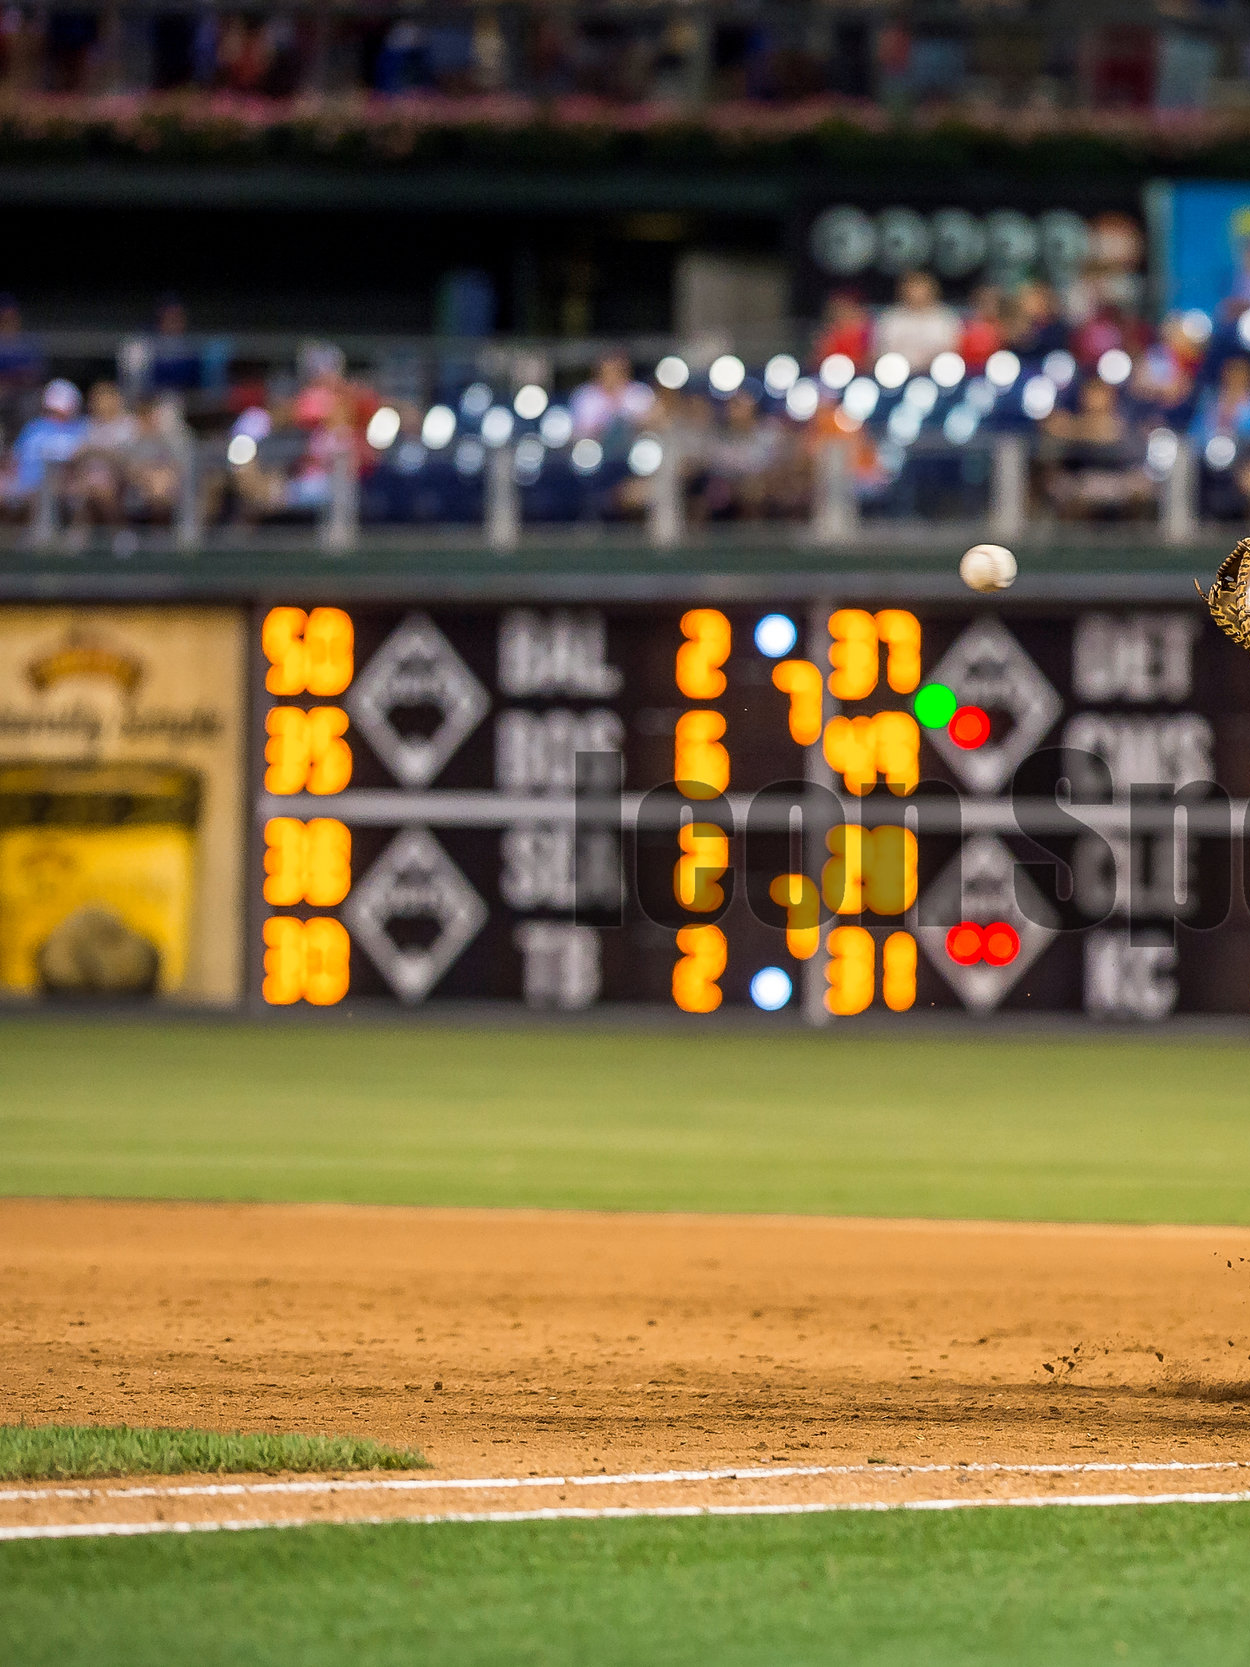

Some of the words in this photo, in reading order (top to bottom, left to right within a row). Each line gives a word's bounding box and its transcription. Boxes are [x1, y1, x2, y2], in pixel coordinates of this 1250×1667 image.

[675, 608, 732, 699] 2
[827, 608, 922, 700] 37
[772, 659, 824, 747] 7
[264, 705, 353, 796] 35
[674, 709, 731, 801] 6
[674, 822, 730, 912] 2
[769, 873, 820, 961] 7
[672, 923, 729, 1014] 2
[824, 924, 918, 1016] 31
